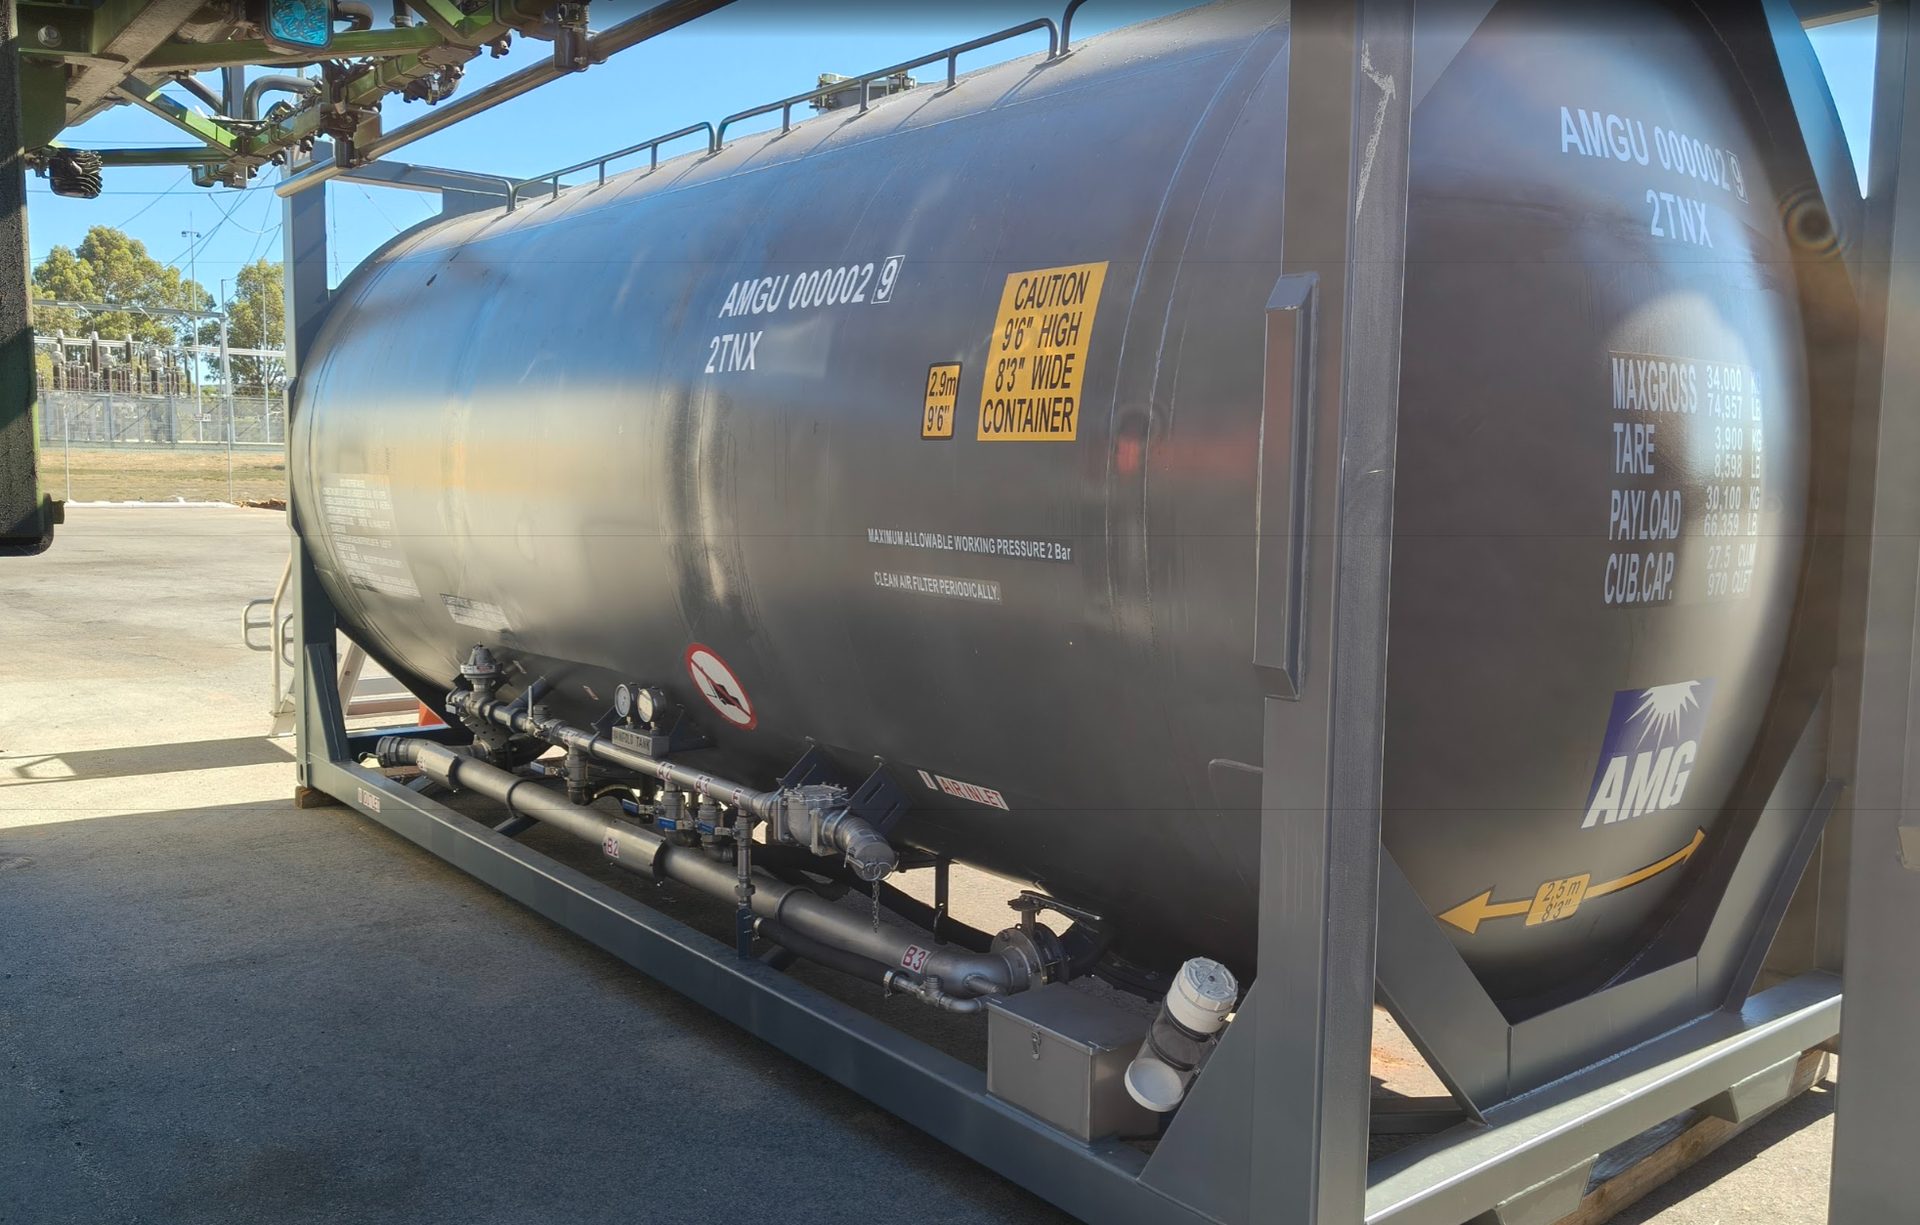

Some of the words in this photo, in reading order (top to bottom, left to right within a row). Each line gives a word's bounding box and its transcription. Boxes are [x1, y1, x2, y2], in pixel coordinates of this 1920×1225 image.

[1560, 106, 1649, 166] AMGU
[1654, 125, 1731, 192] 000002
[1728, 152, 1747, 201] 9
[1646, 188, 1713, 249] 2TNX
[718, 275, 789, 319] AMGU
[788, 262, 875, 311] 000002
[874, 257, 900, 302] 9
[1013, 270, 1091, 312] CAUTION
[705, 330, 763, 374] 2TNX
[1002, 316, 1034, 352] 9'6"
[1037, 312, 1083, 350] HIGH
[928, 370, 957, 397] 2.9m
[995, 356, 1025, 393] 8'3"
[1031, 353, 1076, 391] WIDE
[1612, 357, 1698, 415] MAXGROSS
[1706, 364, 1742, 394] 34,000
[982, 396, 1075, 434] CONTAINER
[1707, 392, 1743, 422] 74,957
[1613, 422, 1656, 475] TARE
[1714, 426, 1743, 455] 3,900
[1714, 454, 1743, 482] 8,598
[1751, 455, 1761, 479] LB
[1608, 489, 1682, 541] PAYLOAD
[1705, 485, 1741, 513] 30,100
[1703, 512, 1739, 539] 66,359
[867, 527, 904, 545] MAXIMUM
[904, 531, 953, 550] ALLOWABLE
[954, 535, 995, 554] WORKING
[996, 538, 1046, 559] PRESSURE
[1047, 542, 1053, 559] 2
[1054, 542, 1071, 561] Bar
[874, 571, 899, 588] CLEAN
[899, 573, 912, 591] AIR
[912, 575, 939, 594] FILTER
[1604, 551, 1675, 605] CUB.CAP.
[940, 777, 963, 798] AIR
[962, 783, 1005, 809] INLET
[1581, 740, 1698, 830] AMG
[902, 946, 927, 971] B3
